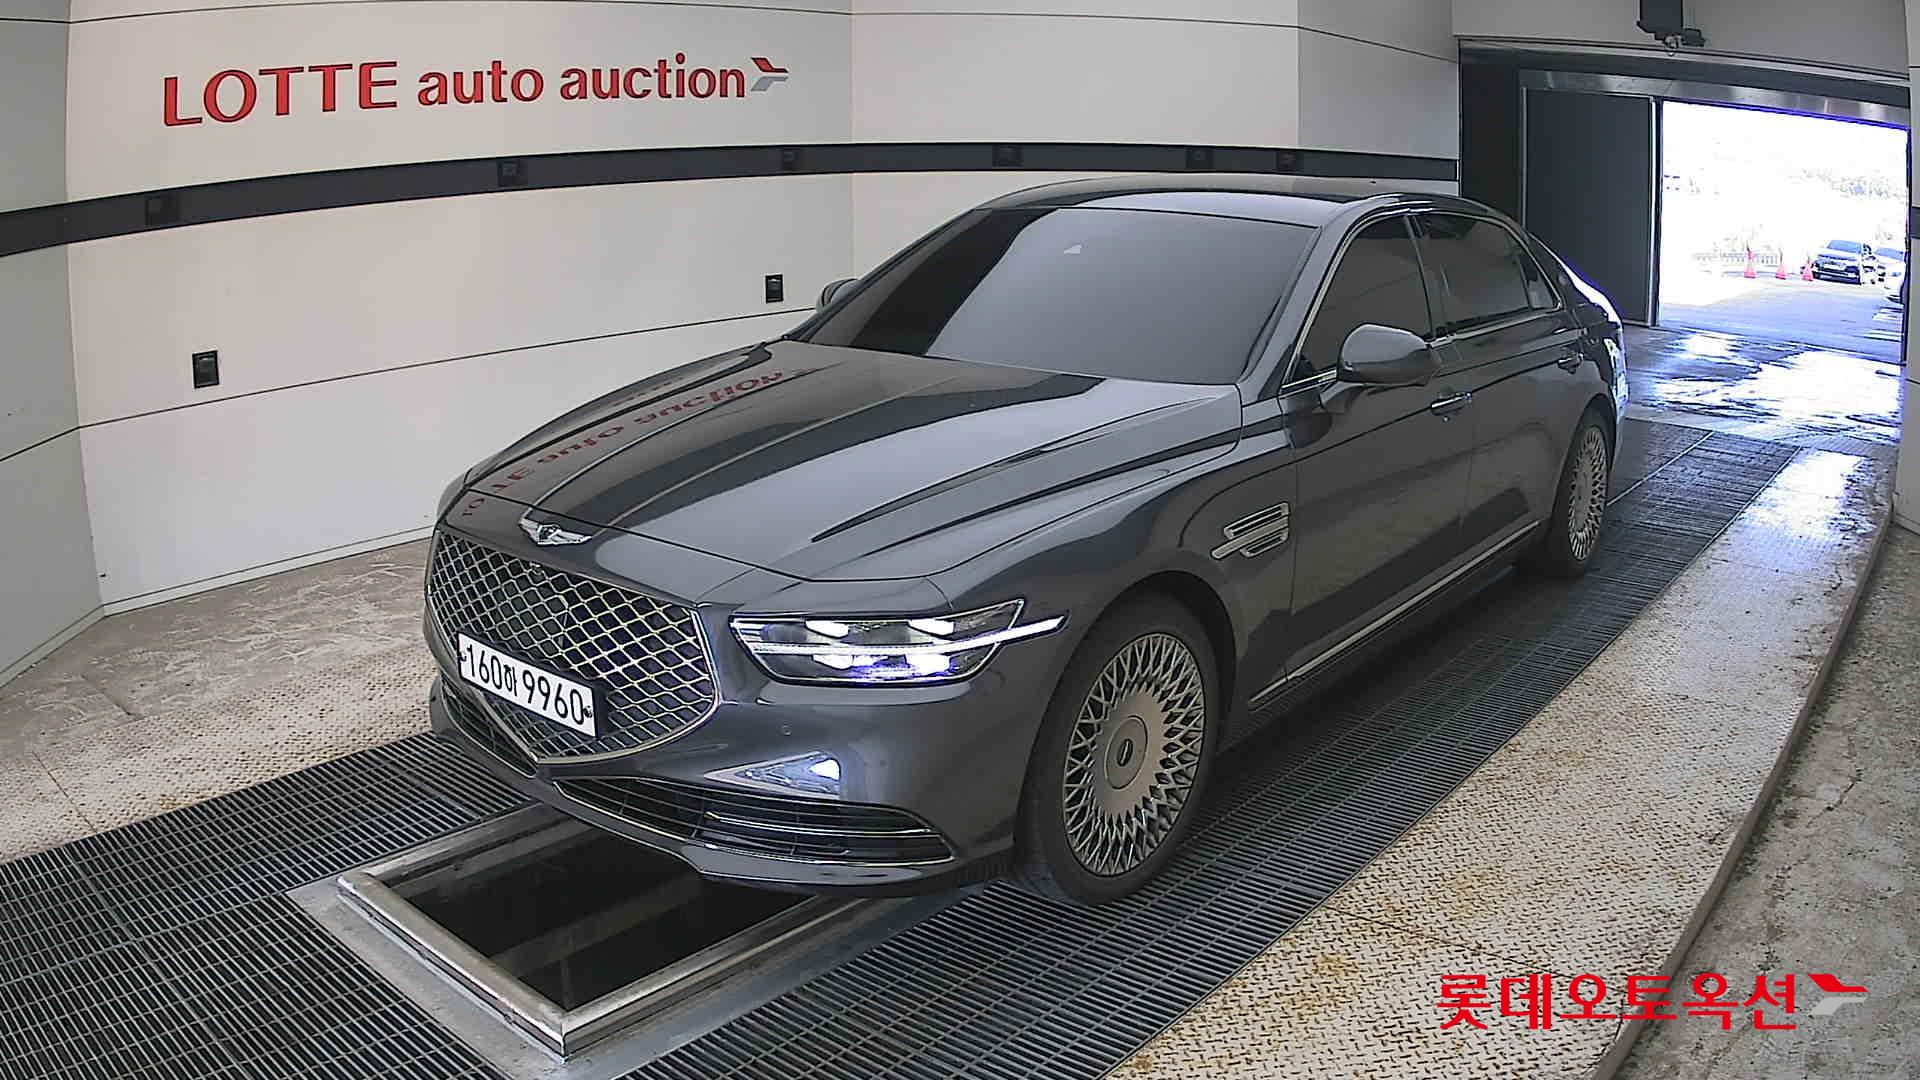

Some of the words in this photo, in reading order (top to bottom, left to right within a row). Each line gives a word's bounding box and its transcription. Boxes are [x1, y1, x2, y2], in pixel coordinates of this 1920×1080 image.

[162, 61, 399, 127] LOTTE
[416, 59, 545, 107] auto
[560, 52, 746, 101] auction
